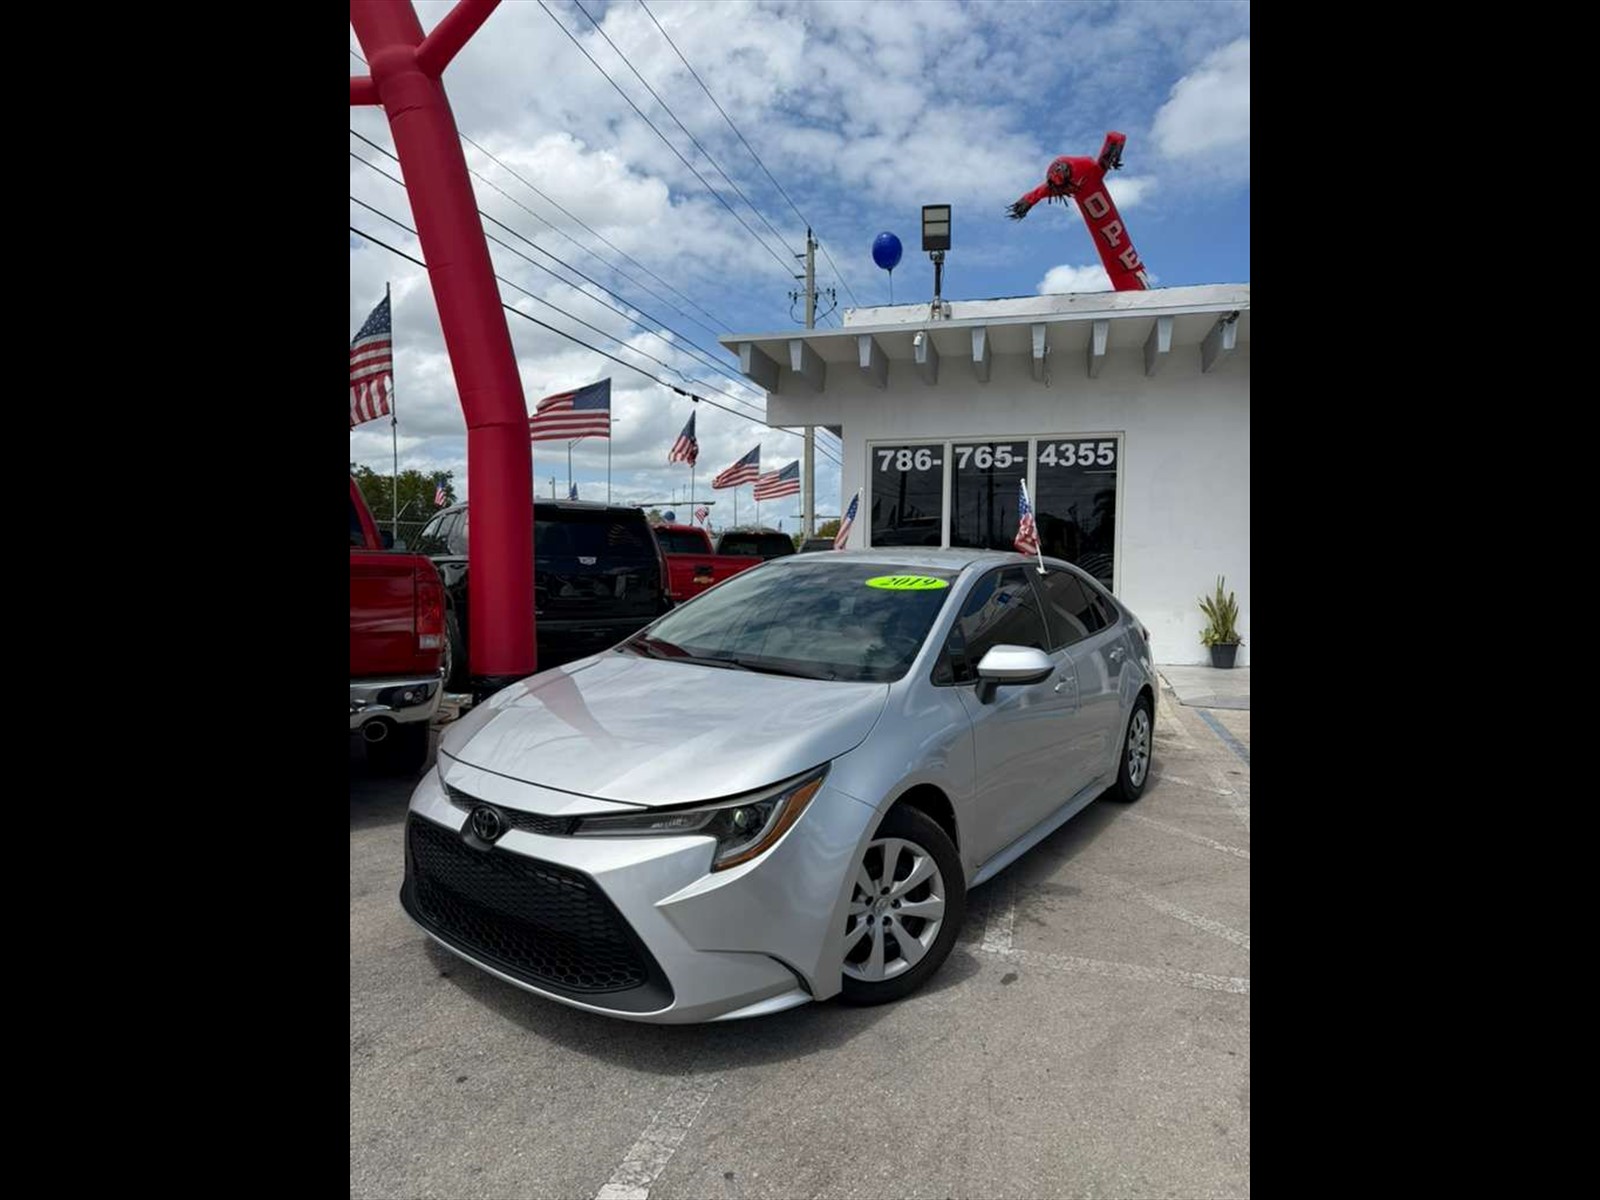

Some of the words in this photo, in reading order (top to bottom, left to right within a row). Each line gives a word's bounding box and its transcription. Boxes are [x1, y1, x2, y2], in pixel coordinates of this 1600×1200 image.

[878, 449, 942, 472] 786-
[955, 446, 1023, 469] 765-
[1039, 442, 1114, 467] 4355
[879, 577, 937, 586] 2019
